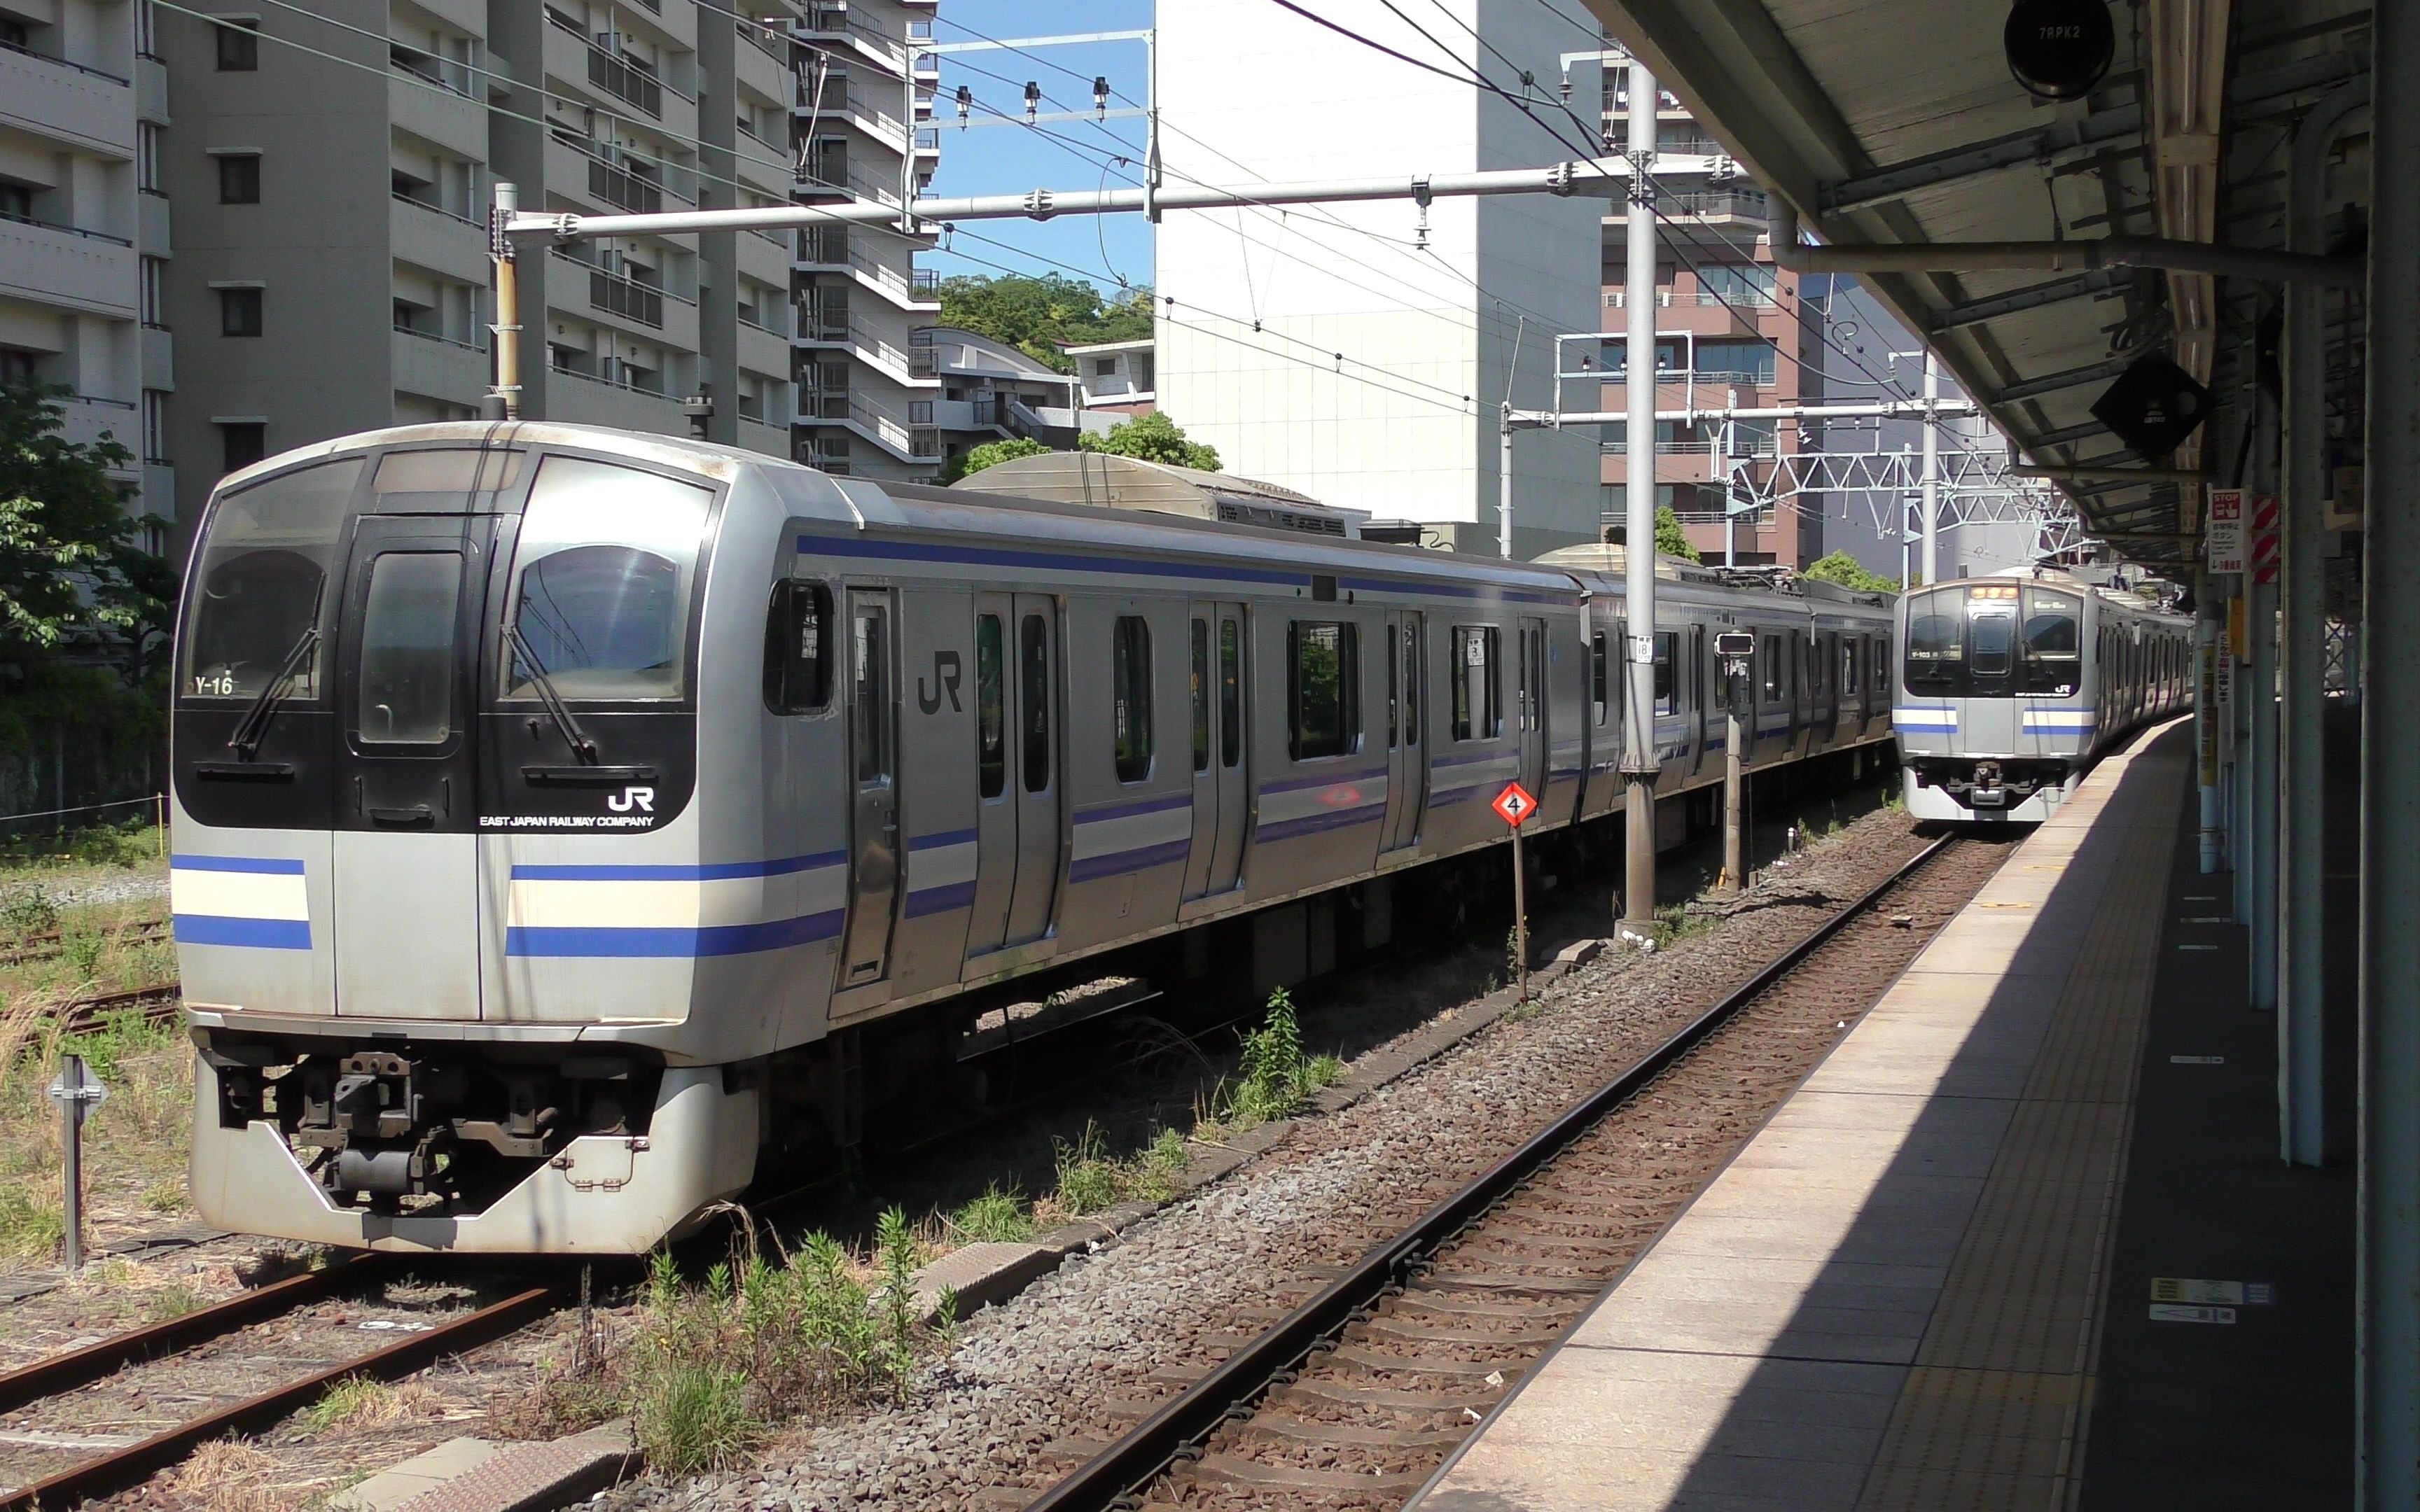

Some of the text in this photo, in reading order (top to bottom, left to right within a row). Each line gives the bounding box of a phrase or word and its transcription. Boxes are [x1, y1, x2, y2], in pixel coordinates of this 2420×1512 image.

[2214, 493, 2239, 502] STOP
[1639, 644, 1647, 654] 18
[195, 676, 232, 694] Y-16
[918, 651, 962, 715] JR
[608, 786, 654, 811] JR
[1507, 797, 1520, 811] 4
[480, 816, 654, 827] EAST JAPAN RAILWAY COMPANY
